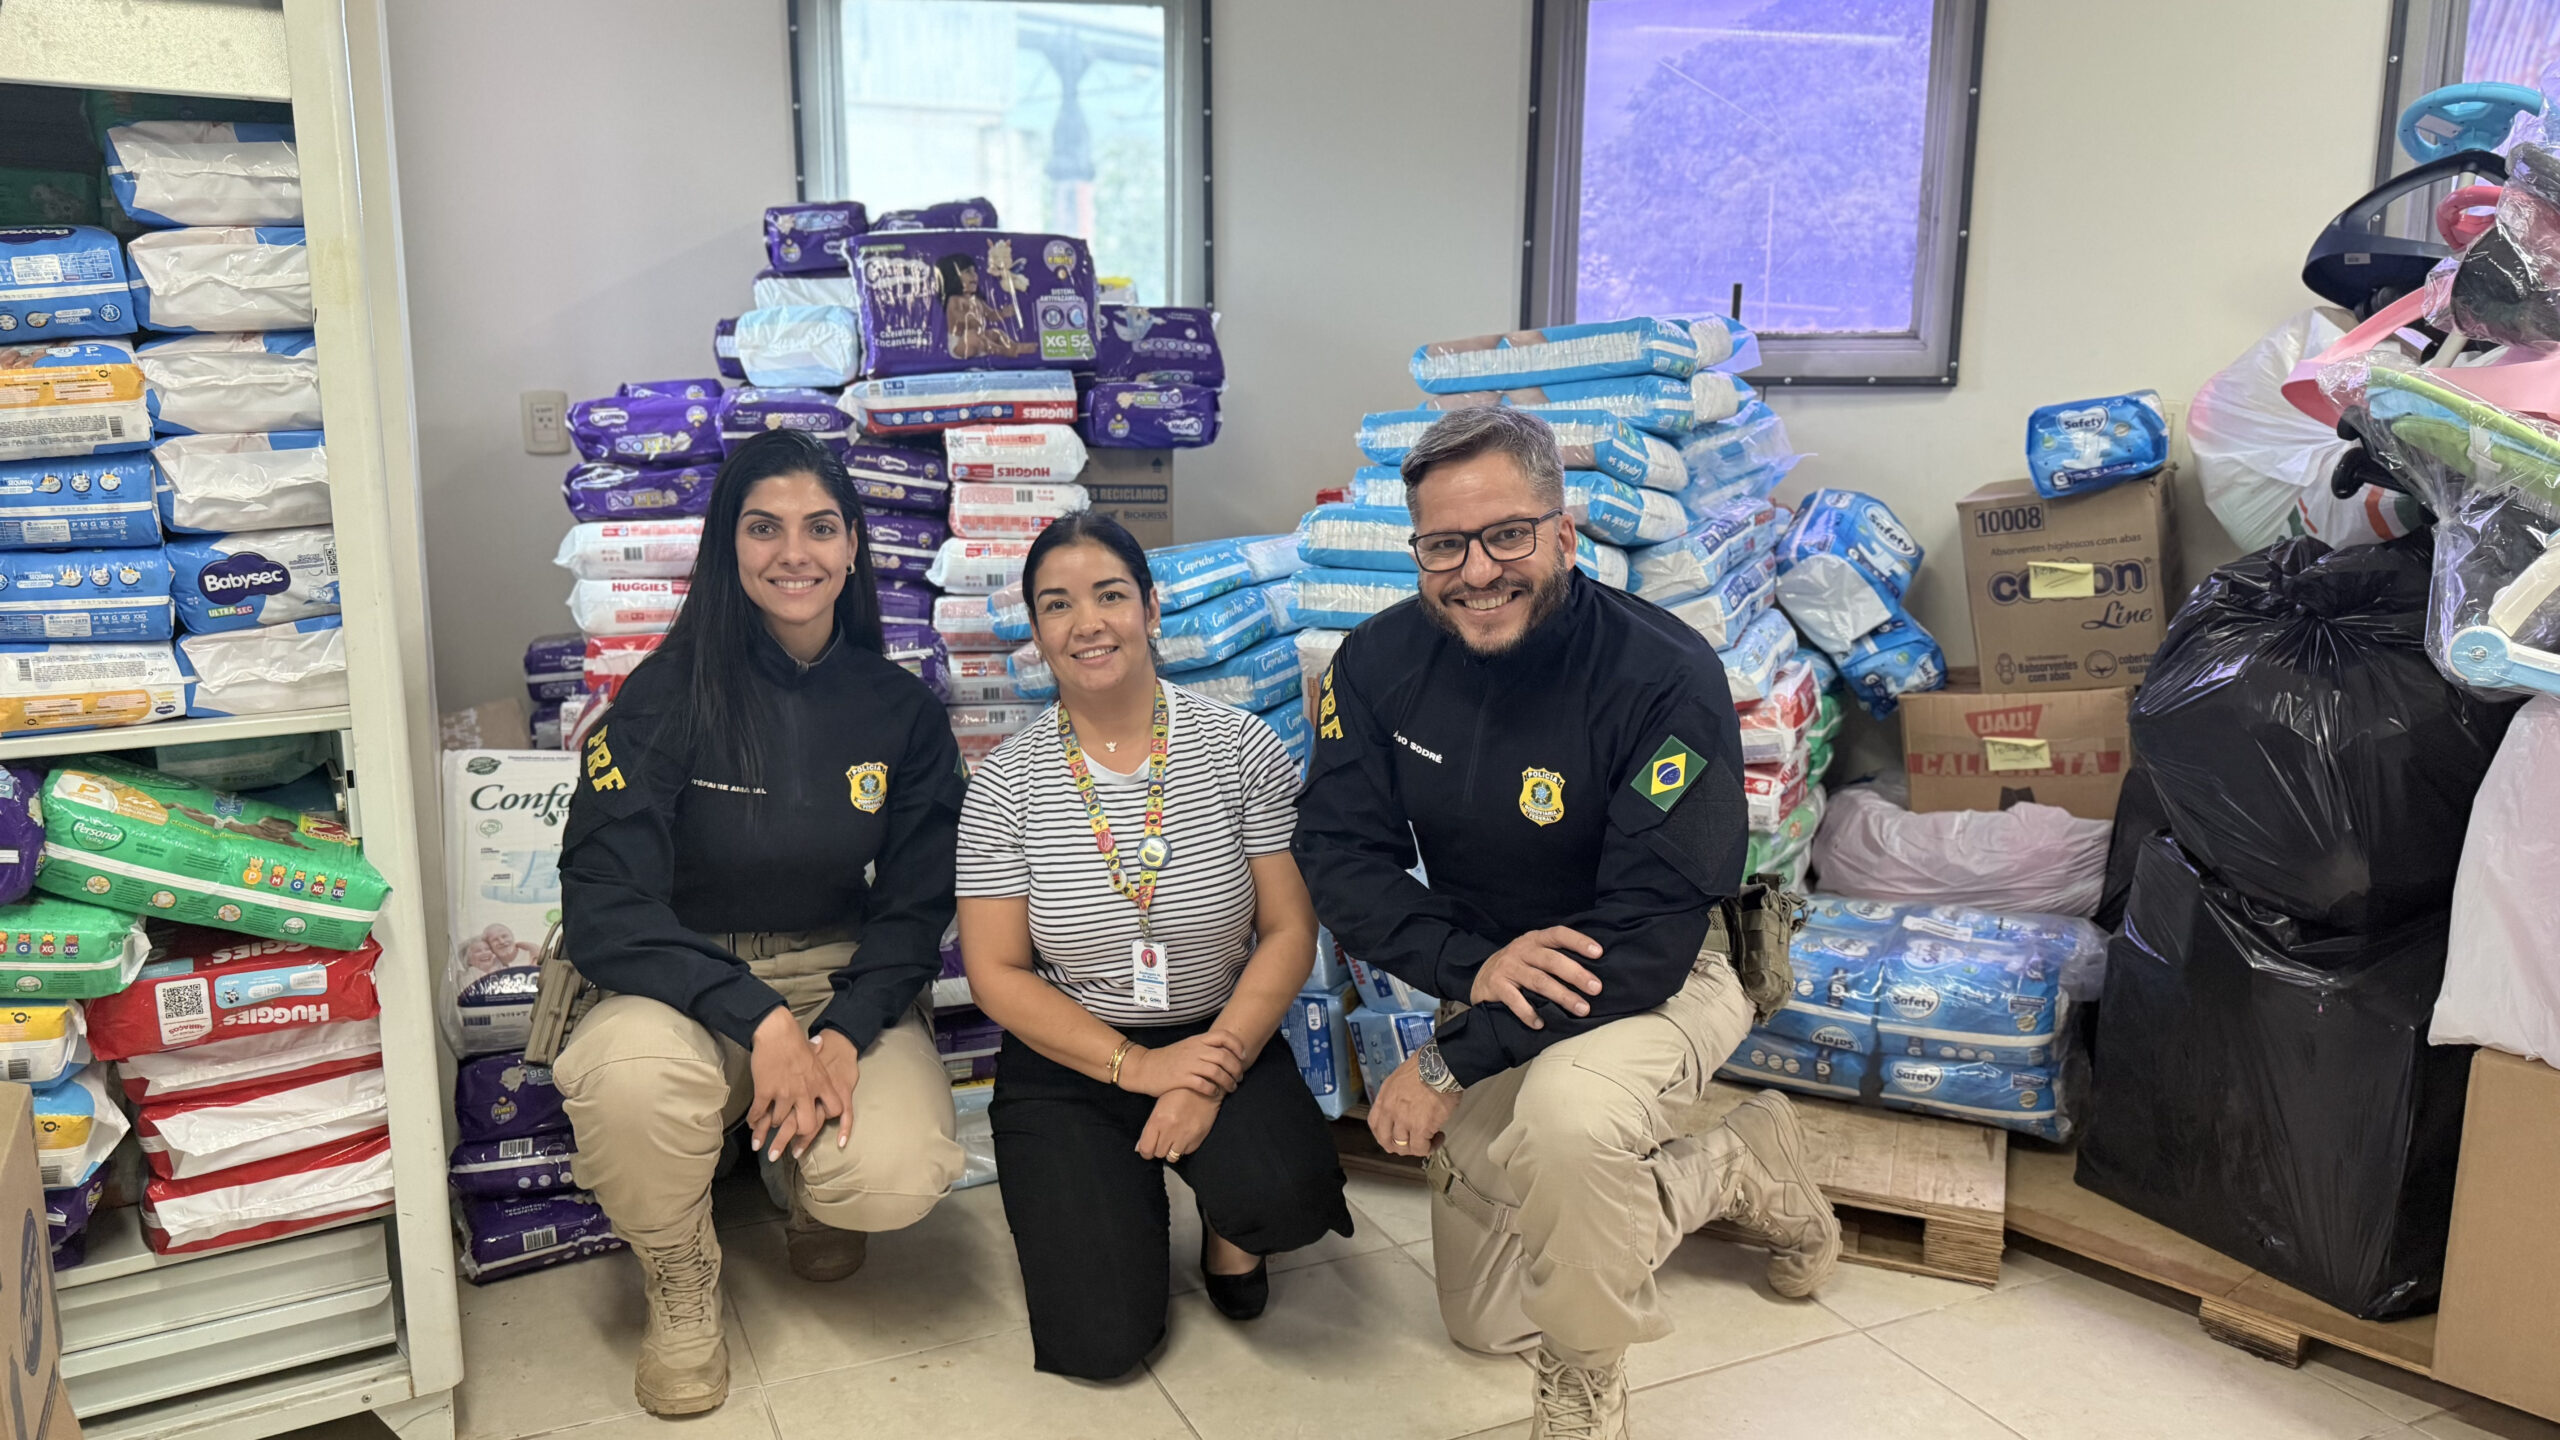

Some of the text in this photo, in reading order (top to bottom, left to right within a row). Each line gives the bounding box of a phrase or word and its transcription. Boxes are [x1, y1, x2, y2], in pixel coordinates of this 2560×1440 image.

[1046, 334, 1090, 347] XG 52
[86, 346, 99, 354] P
[1023, 407, 1074, 420] HUGGIES
[2064, 416, 2104, 430] Safety
[997, 466, 1050, 477] HUGGIES
[2053, 471, 2068, 486] G
[1100, 488, 1166, 501] RECICLAMOS
[1977, 506, 2041, 534] 10008
[1867, 511, 1913, 553] Safety
[1991, 533, 2142, 556] Absorventes higiênicos com abas
[1177, 554, 1216, 575] Capricho
[204, 570, 284, 593] Babysec
[612, 582, 668, 592] HUGGIES
[1990, 561, 2145, 603] con
[208, 605, 254, 617] ULTRA SEC
[1212, 598, 1243, 627] Capricho
[2081, 600, 2153, 630] Line
[1320, 664, 1344, 740] PRF
[1977, 710, 2032, 734] UAU!
[587, 724, 627, 792] PRF
[1409, 742, 1443, 764] SODRÉ
[78, 783, 101, 794] P
[74, 822, 124, 842] Personal
[249, 871, 344, 897] P M G XG XXG
[19, 944, 28, 952] G
[41, 945, 54, 953] XG
[1890, 994, 1935, 1012] Safety
[222, 1003, 330, 1026] HUGGIES
[168, 1023, 206, 1035] ABRAÇOS
[1814, 1031, 1854, 1050] Safety
[530, 1069, 544, 1079] 36
[1817, 1063, 1830, 1075] G
[1894, 1068, 1937, 1086] Safety
